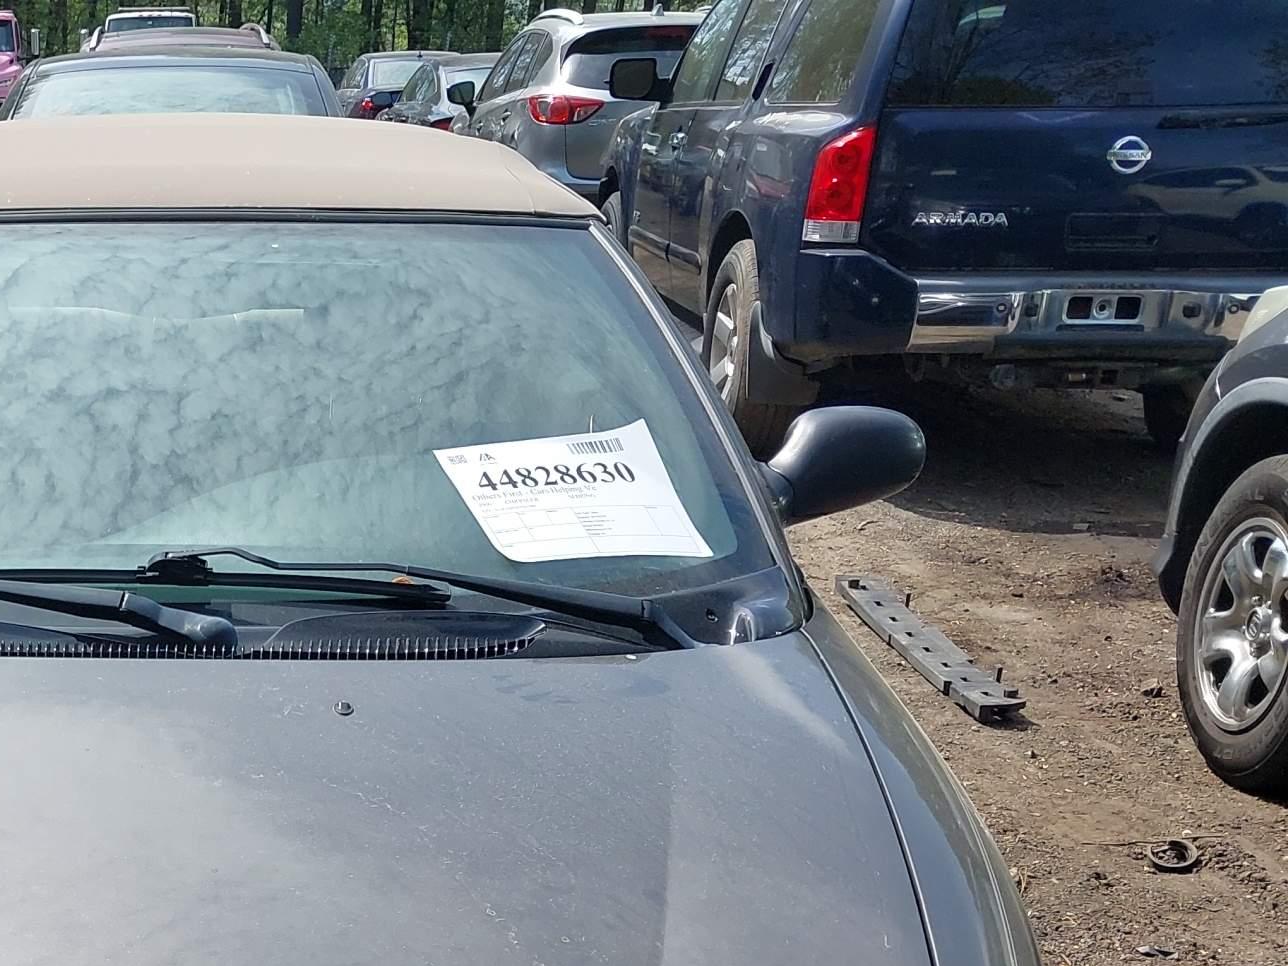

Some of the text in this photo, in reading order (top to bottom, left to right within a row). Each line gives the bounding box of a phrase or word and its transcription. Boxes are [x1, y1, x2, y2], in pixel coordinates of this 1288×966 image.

[911, 211, 1009, 227] ARMADA
[478, 461, 636, 491] 44828630
[530, 487, 550, 496] Cars
